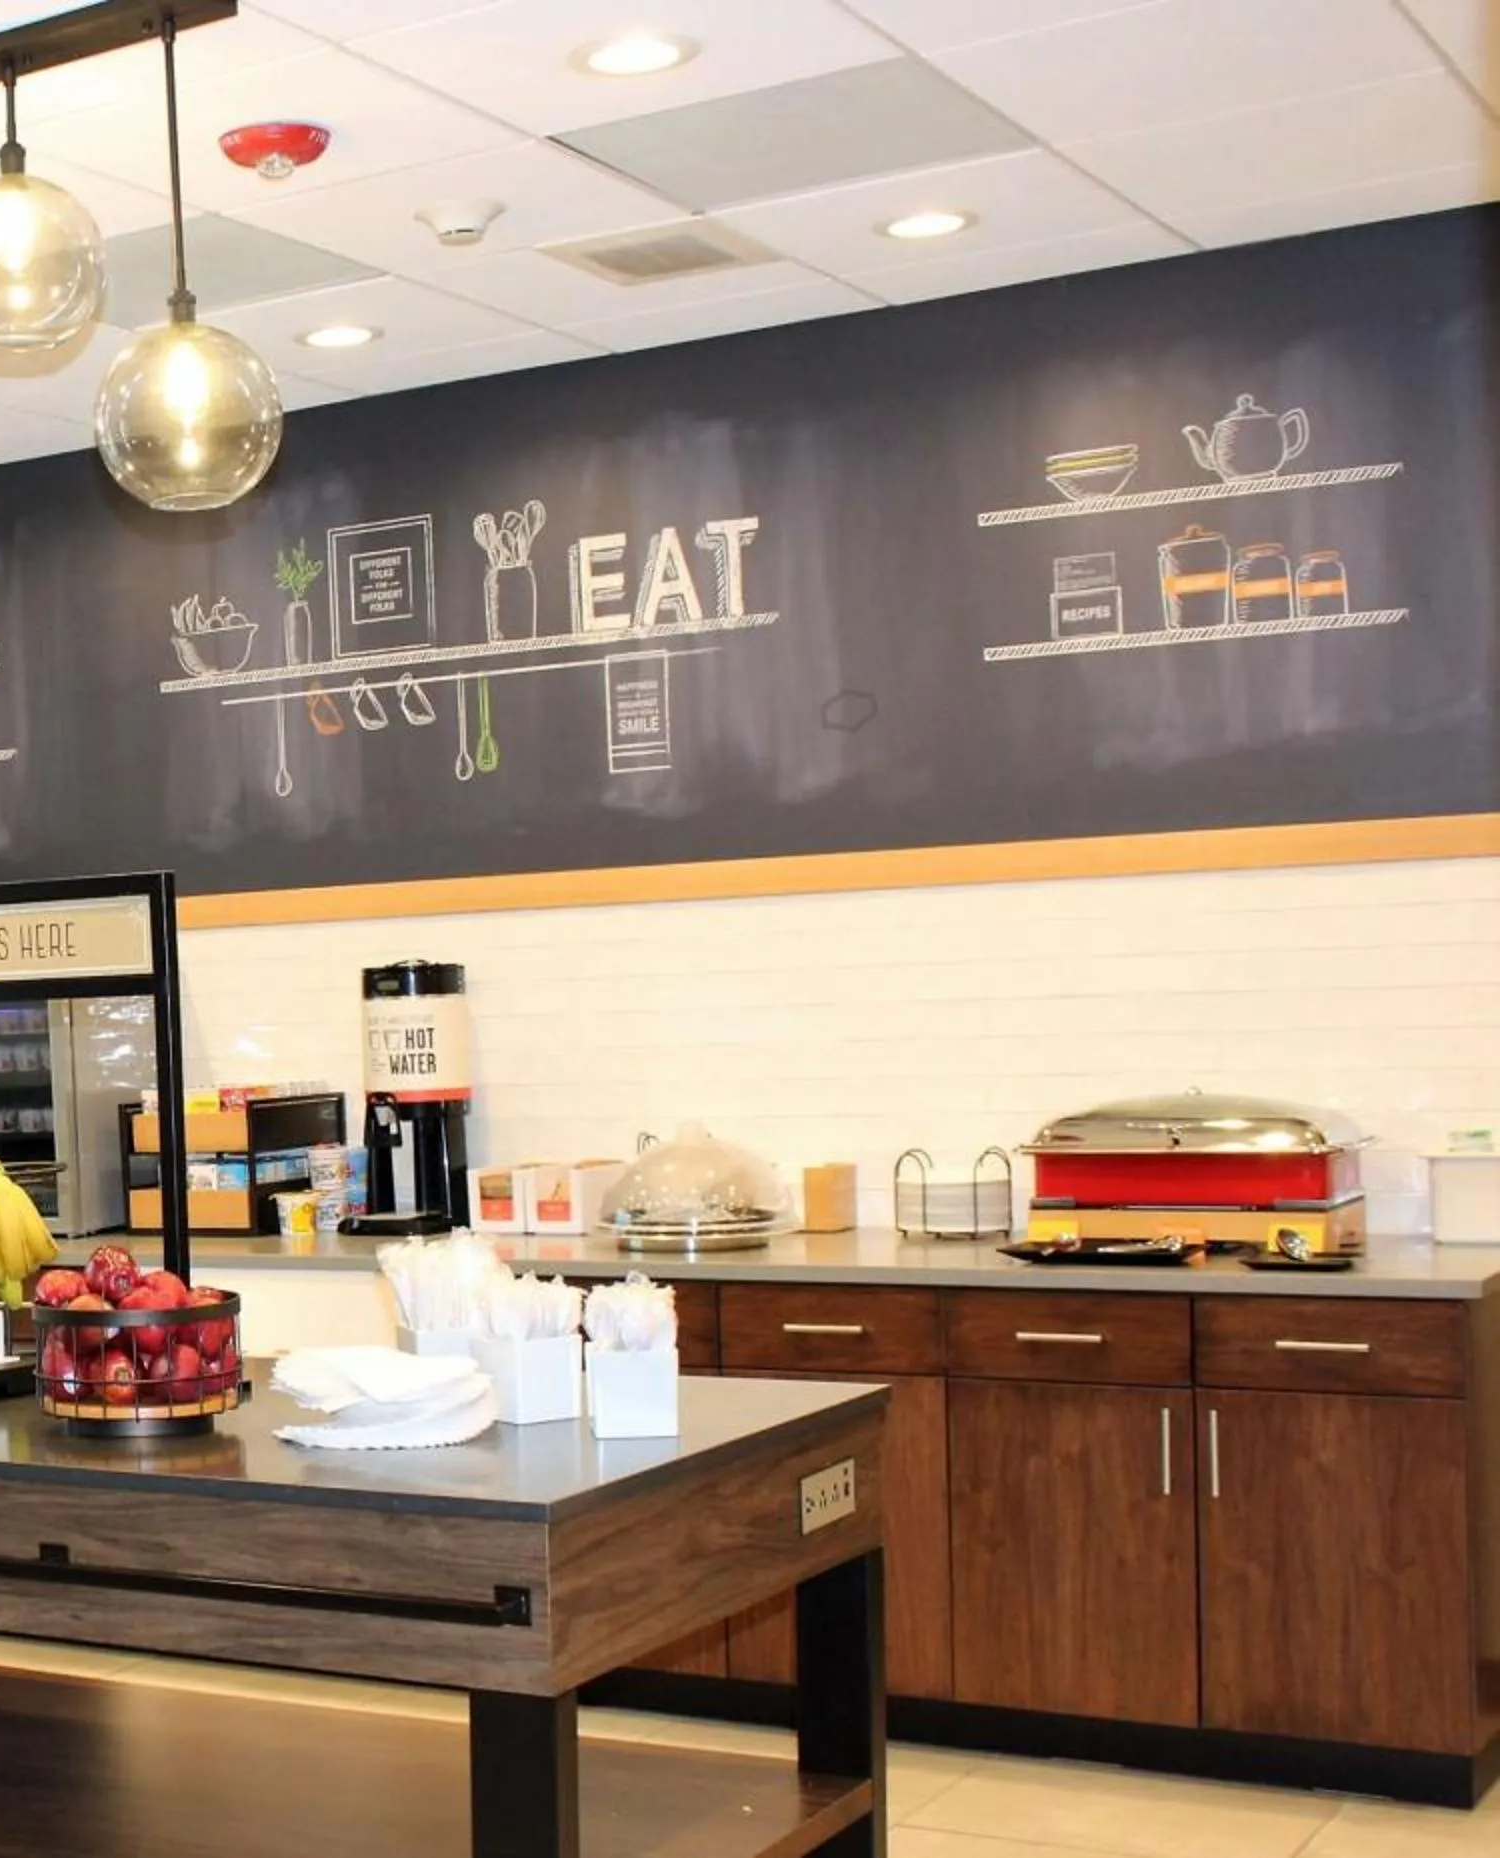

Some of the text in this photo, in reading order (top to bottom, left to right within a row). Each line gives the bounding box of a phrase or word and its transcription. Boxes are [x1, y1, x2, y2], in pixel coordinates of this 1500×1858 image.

[571, 516, 760, 633] EAT
[1061, 605, 1111, 623] RECIPES
[618, 716, 660, 735] SMILE
[19, 921, 77, 959] HERE
[405, 1027, 436, 1049] HOT
[389, 1053, 437, 1075] WATER
